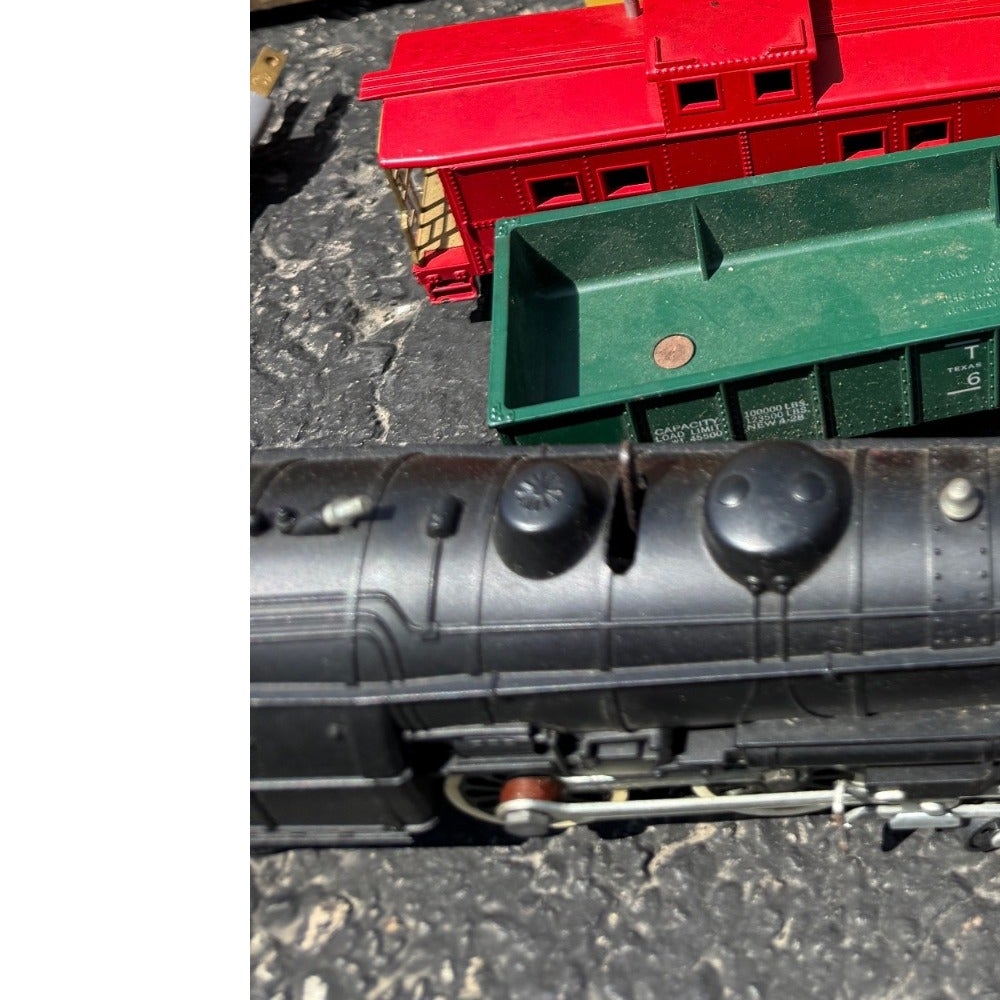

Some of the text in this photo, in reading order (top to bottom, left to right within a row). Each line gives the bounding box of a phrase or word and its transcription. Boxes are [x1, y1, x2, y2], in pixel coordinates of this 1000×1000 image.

[963, 344, 980, 360] T
[946, 361, 982, 373] TEXAS
[654, 416, 718, 436] CAPACITY
[655, 423, 721, 444] LOAD LIMIT
[746, 419, 777, 432] NEW
